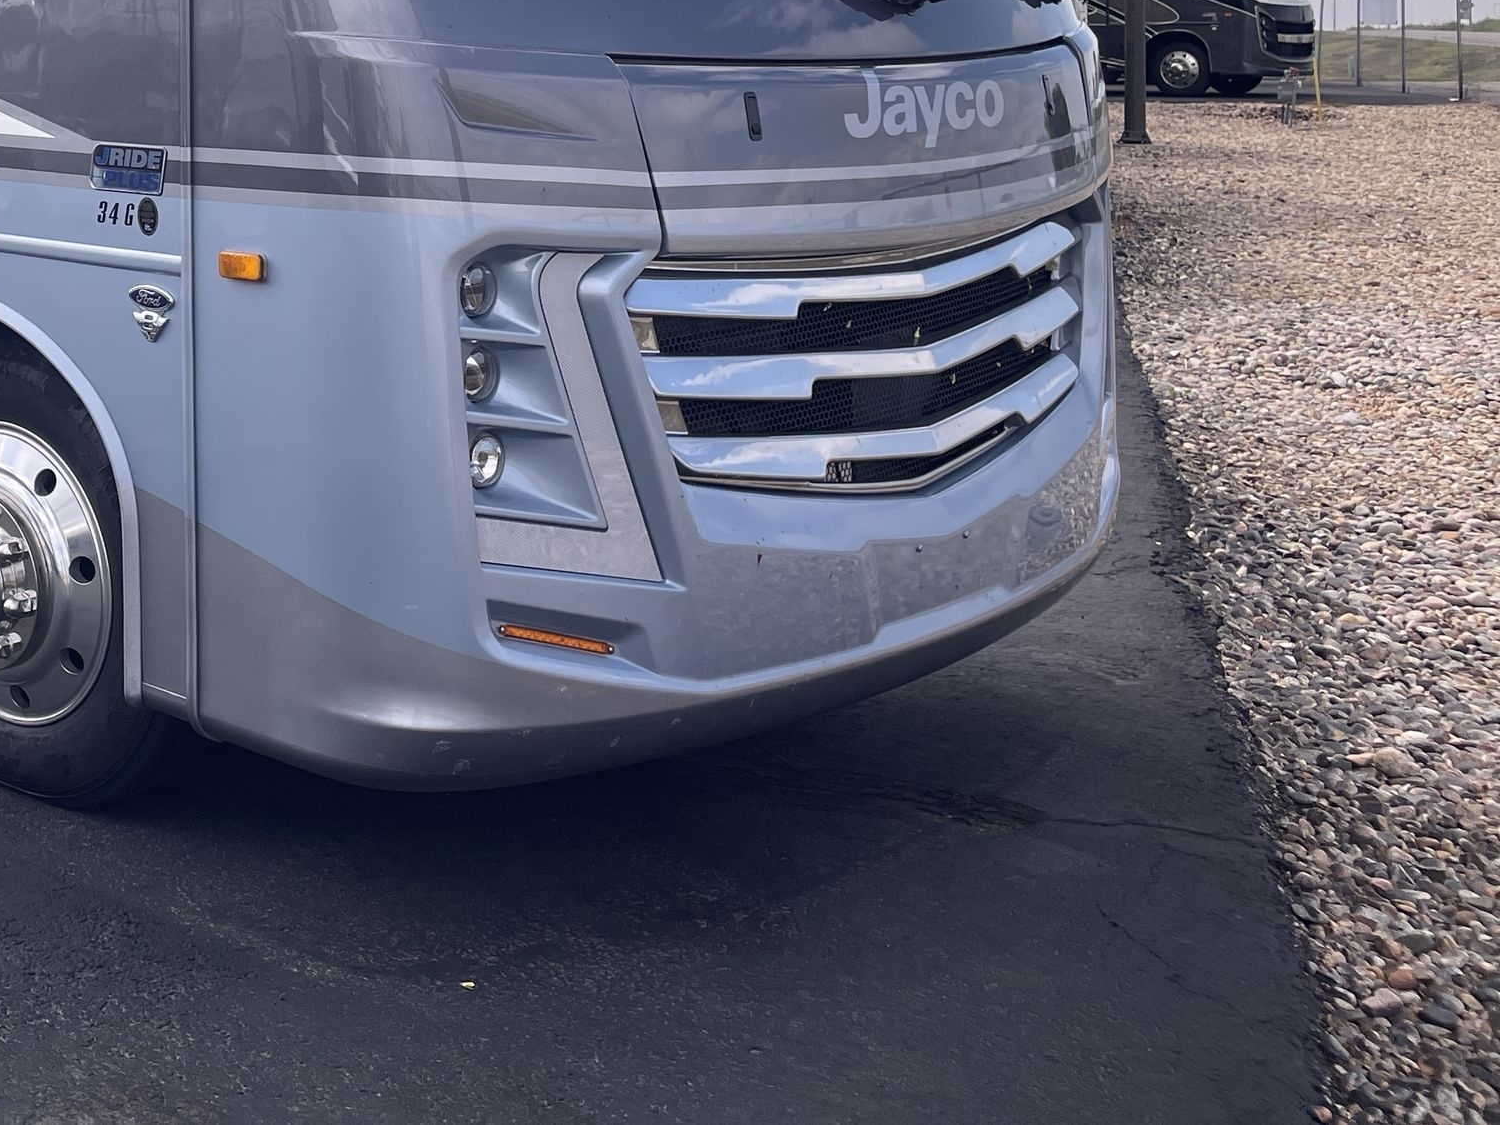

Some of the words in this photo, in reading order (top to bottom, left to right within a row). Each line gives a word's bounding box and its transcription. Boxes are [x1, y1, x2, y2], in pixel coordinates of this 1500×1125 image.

[844, 69, 1005, 149] Jayco
[94, 146, 163, 170] JRIDE
[102, 170, 160, 192] PLUS
[136, 288, 162, 307] Ford
